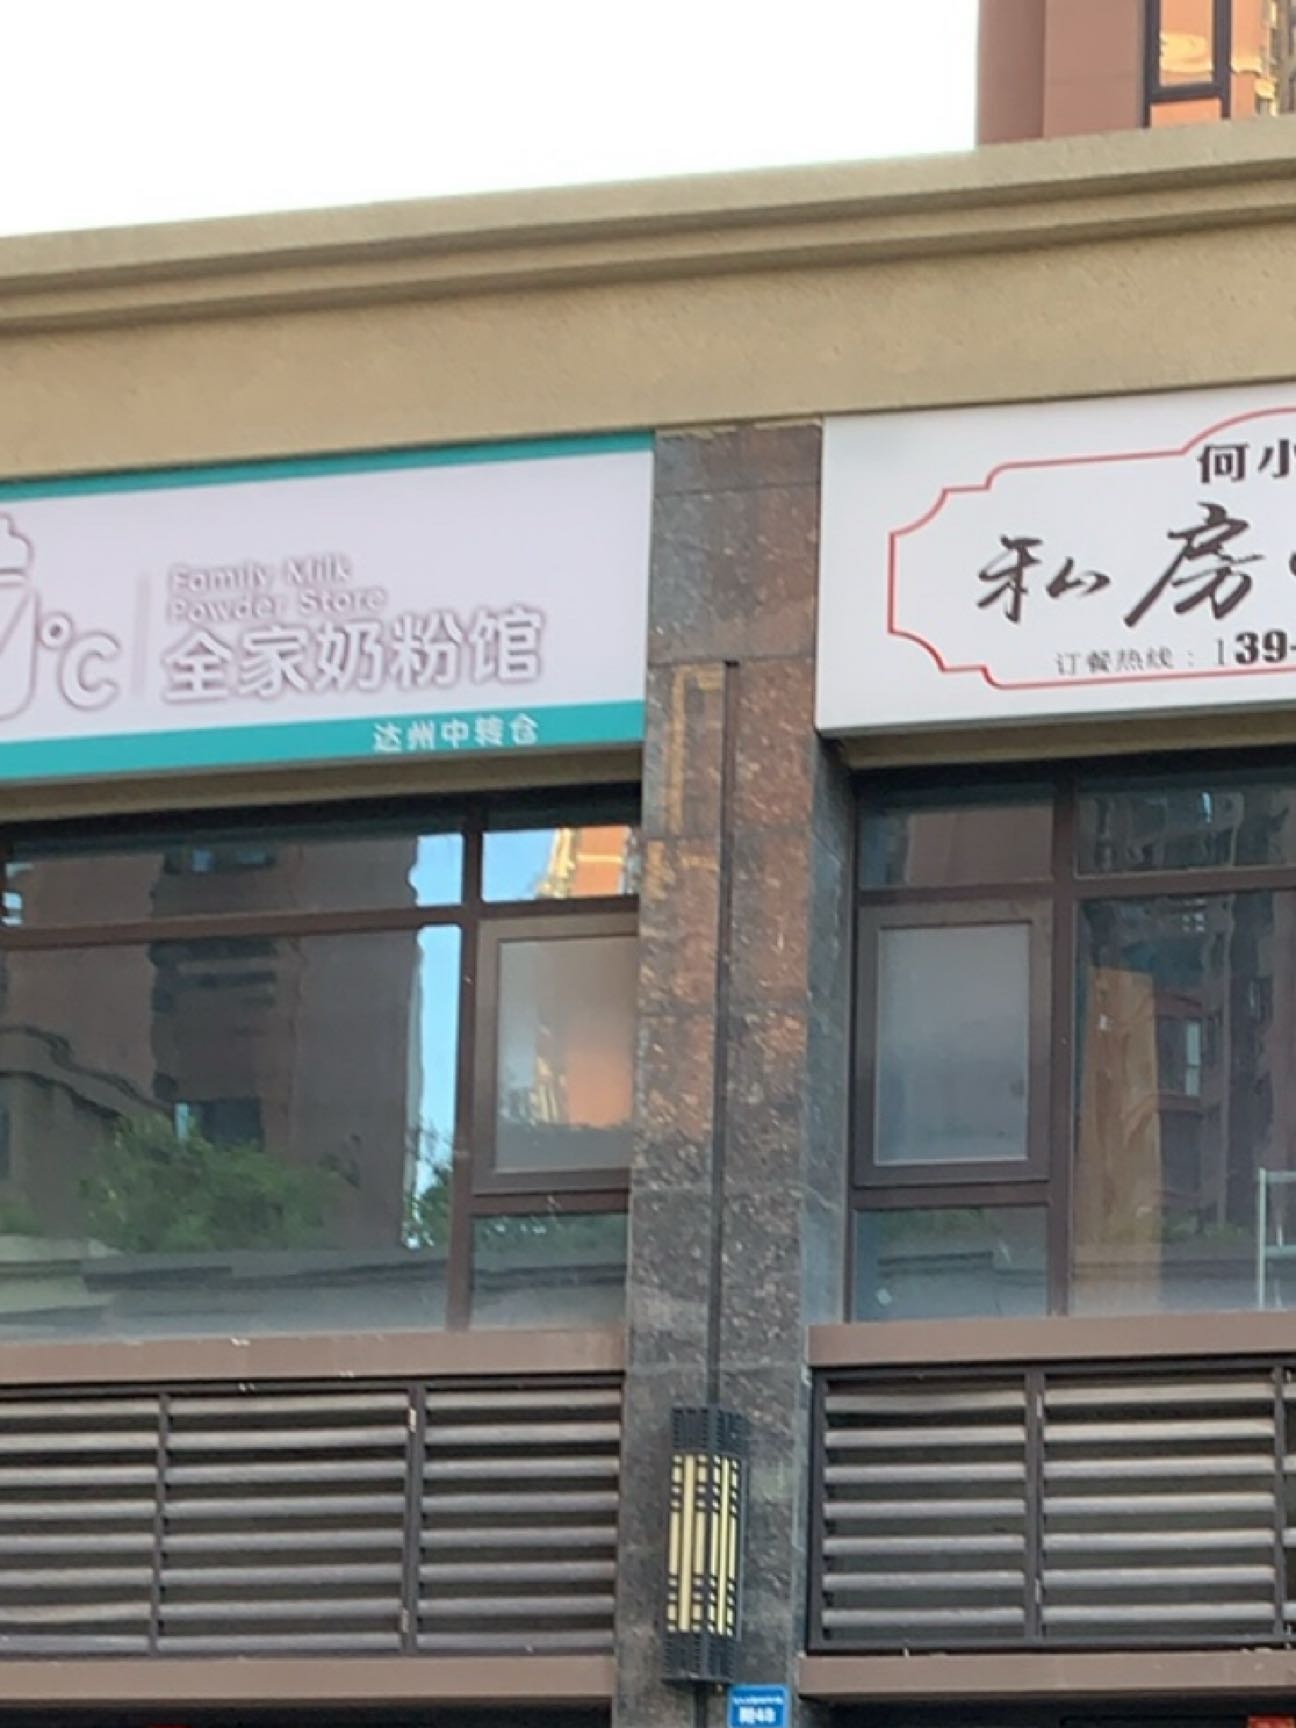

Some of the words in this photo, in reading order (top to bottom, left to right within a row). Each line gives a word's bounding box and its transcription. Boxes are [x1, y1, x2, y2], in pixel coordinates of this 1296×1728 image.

[169, 563, 267, 594] Family
[286, 554, 350, 586] Milk
[169, 596, 284, 624] Powder
[299, 586, 386, 614] Store
[163, 604, 547, 702] 全家奶粉馆
